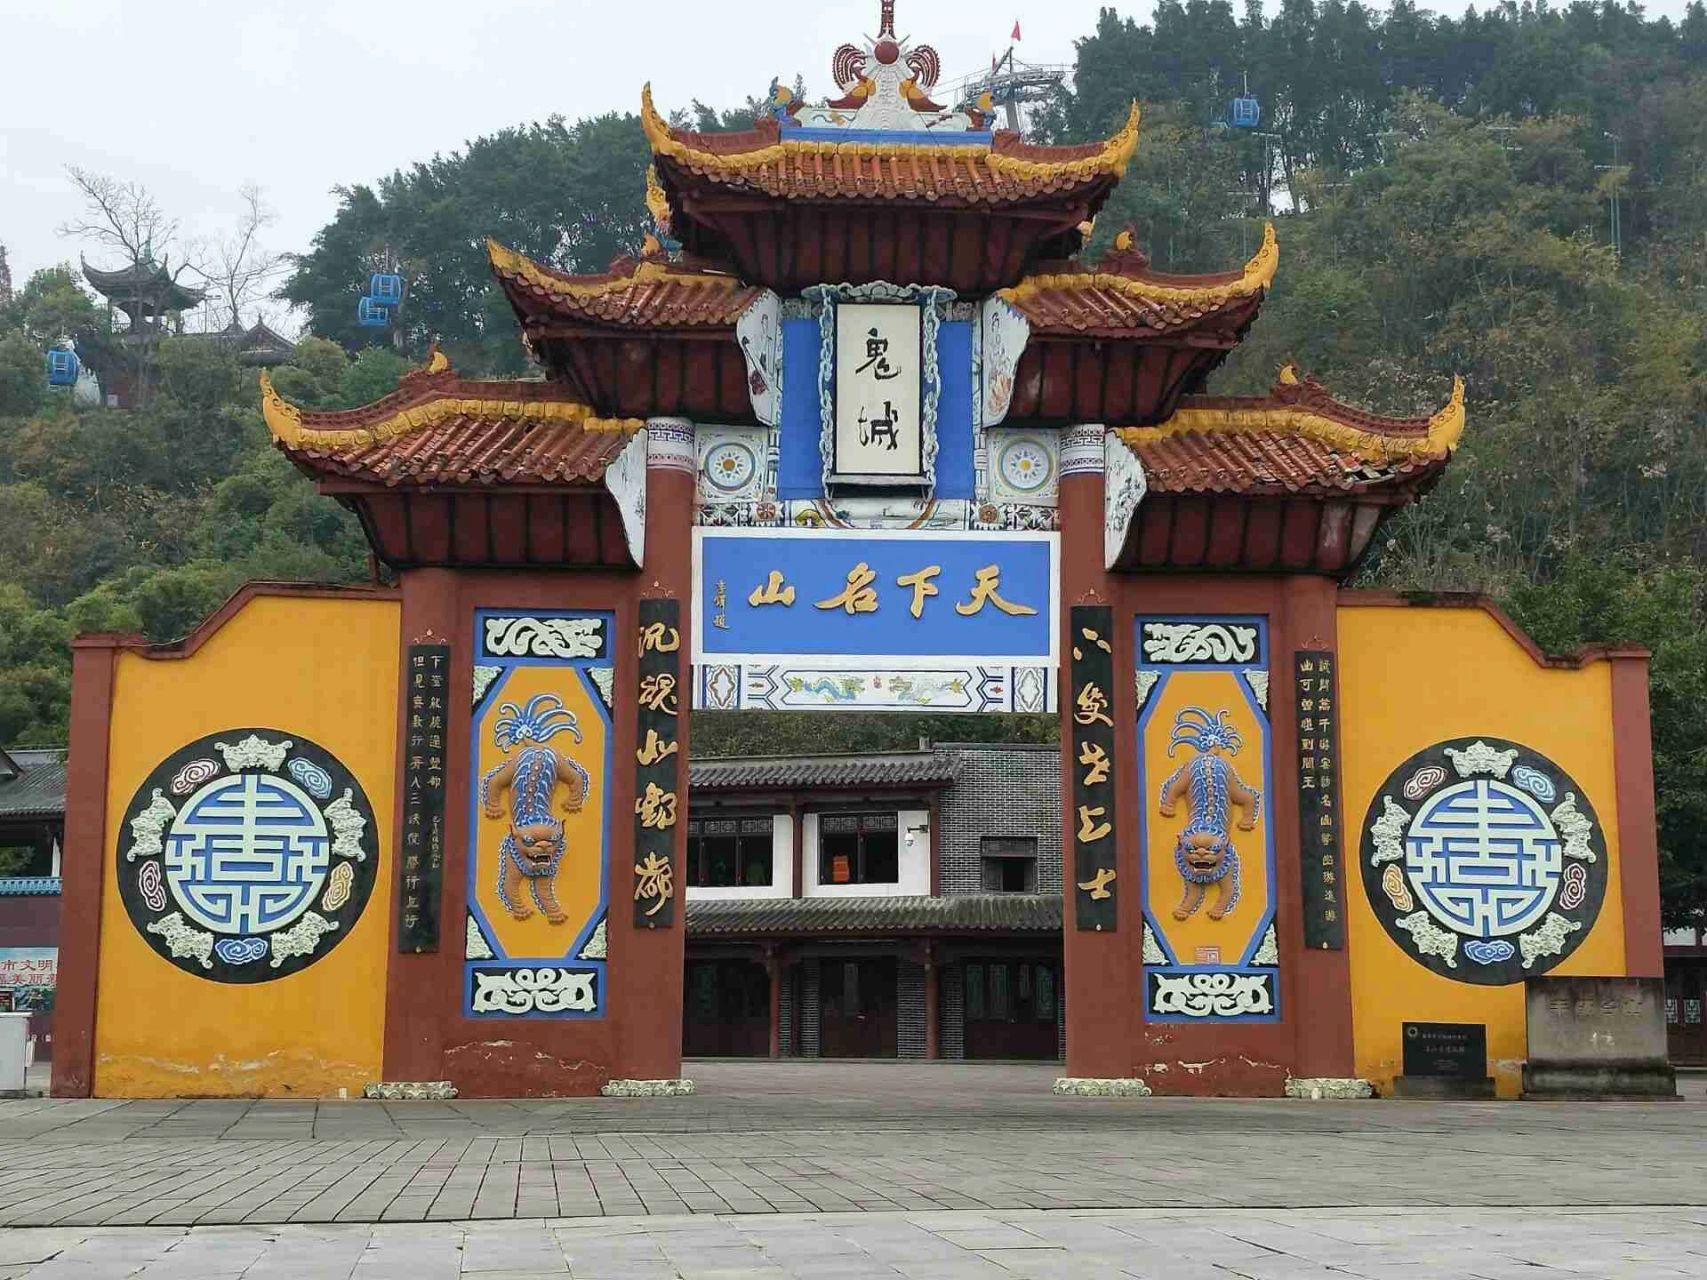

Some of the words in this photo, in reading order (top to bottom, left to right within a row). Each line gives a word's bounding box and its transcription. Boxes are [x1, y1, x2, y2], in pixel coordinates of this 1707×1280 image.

[855, 327, 902, 451] 鬼城
[747, 561, 1040, 617] 天下名山
